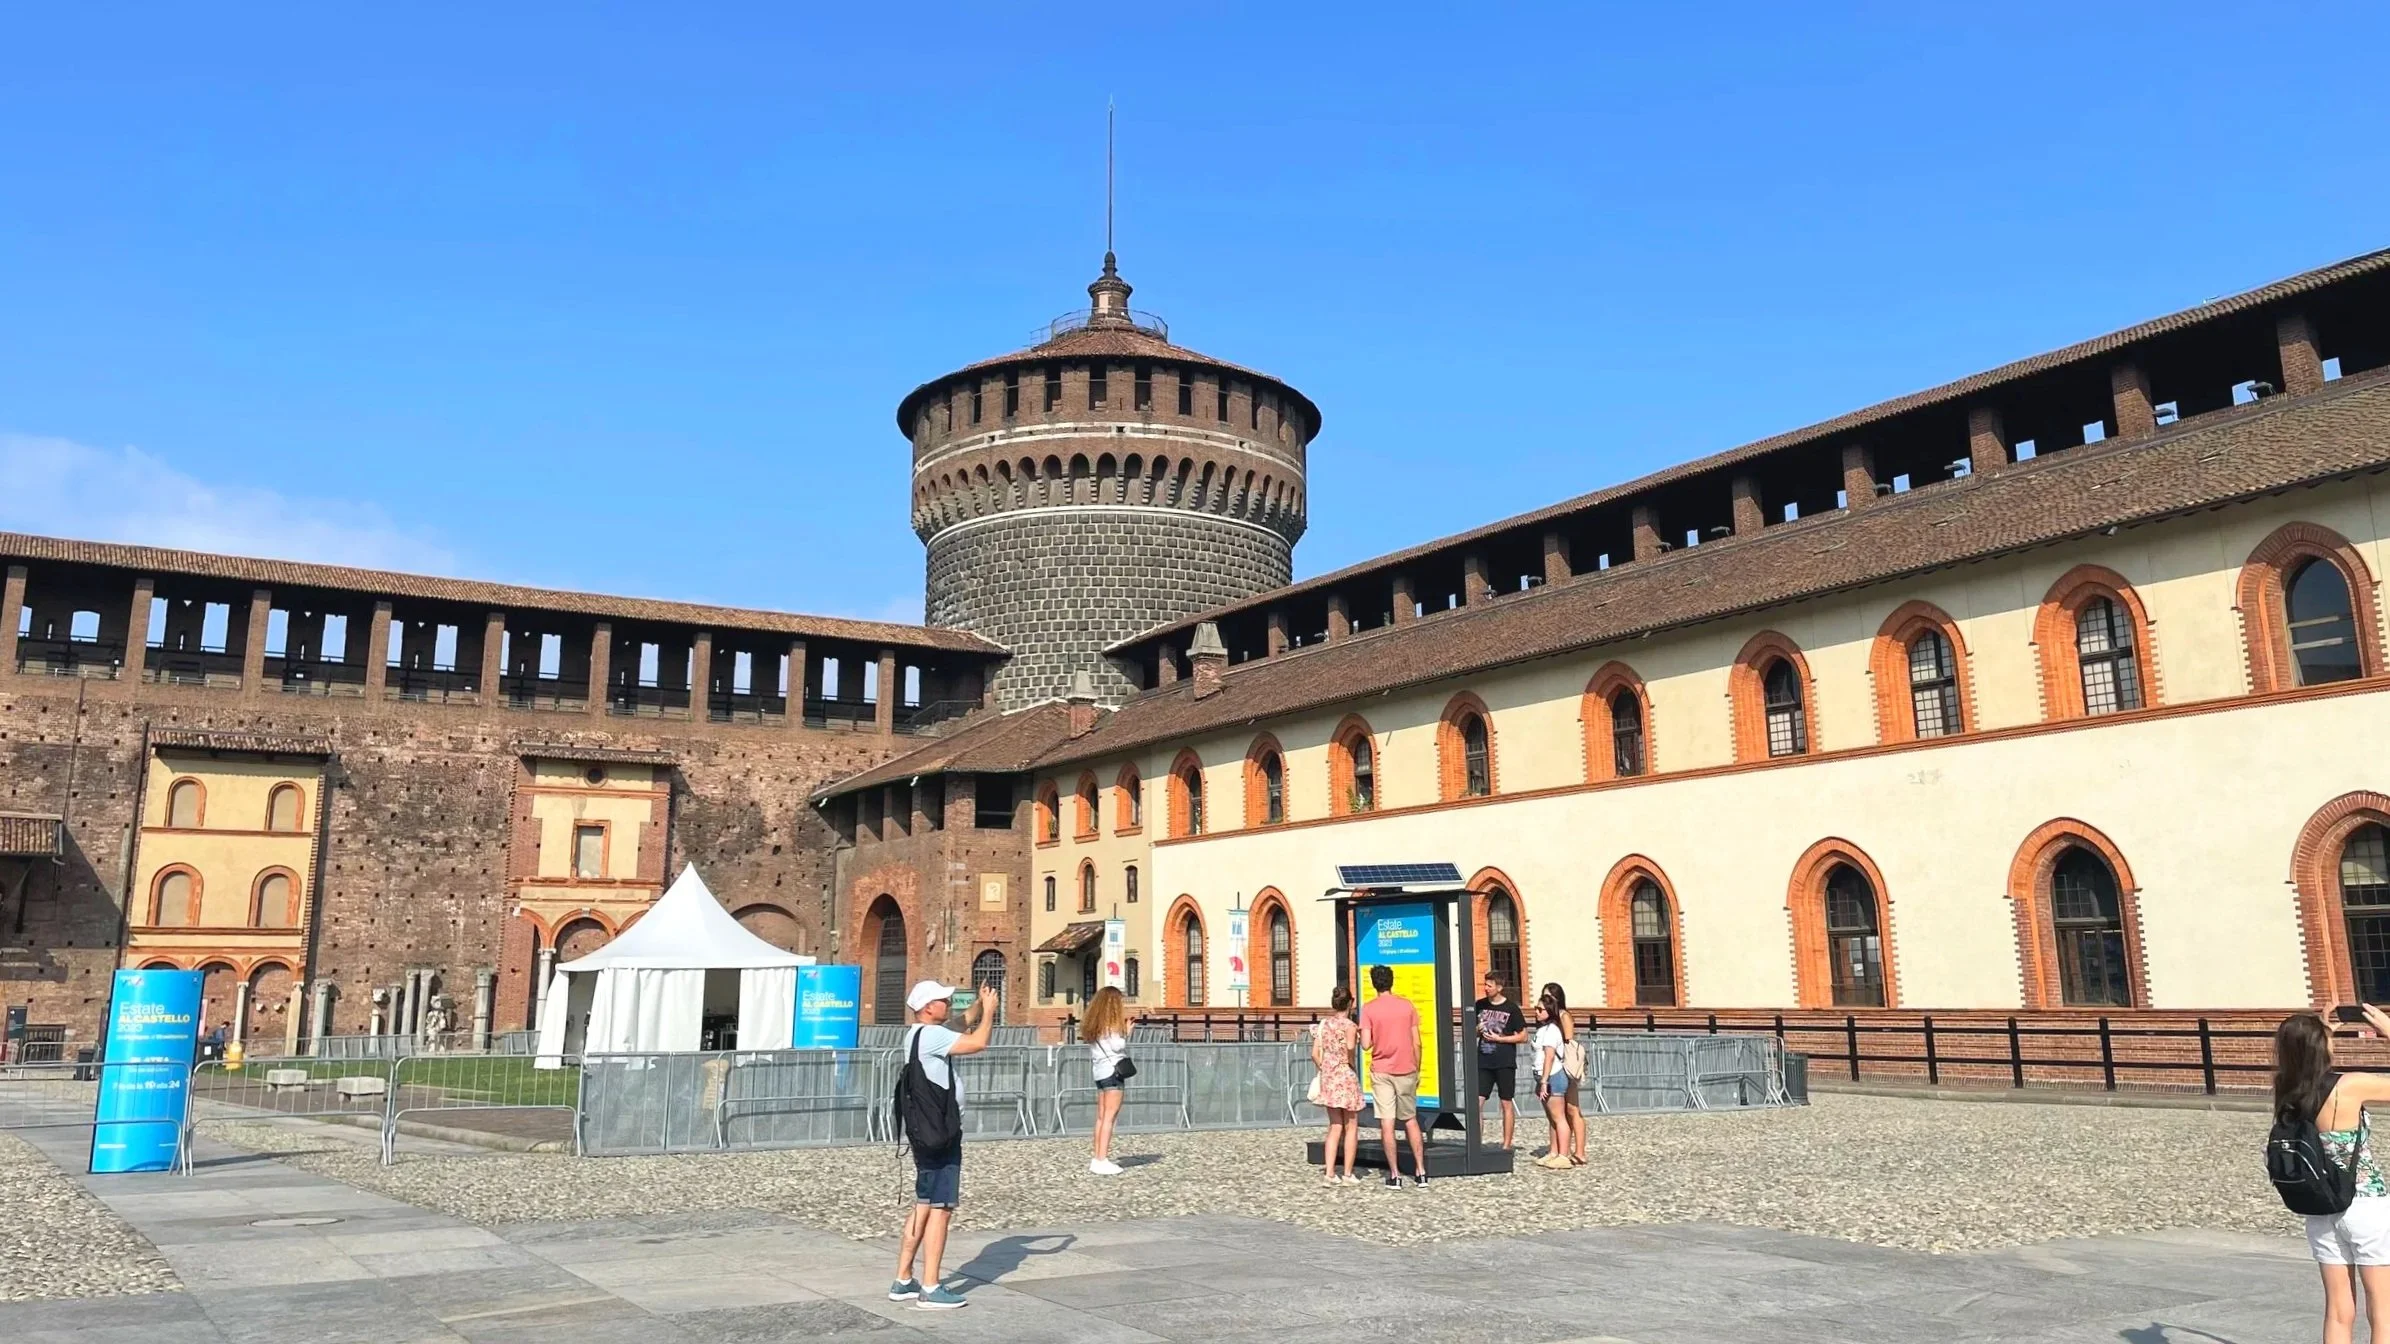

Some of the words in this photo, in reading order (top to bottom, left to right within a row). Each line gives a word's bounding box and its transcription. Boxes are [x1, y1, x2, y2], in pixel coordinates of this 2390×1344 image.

[1377, 919, 1403, 930] Estate
[1378, 930, 1387, 939] AL
[1387, 929, 1419, 938] CASTELLO
[803, 990, 836, 1001] Estate
[120, 1002, 165, 1015] Estate
[118, 1015, 132, 1024] AL
[133, 1014, 191, 1024] CASTELLO
[117, 1024, 144, 1033] 2023
[168, 1080, 180, 1089] 24
